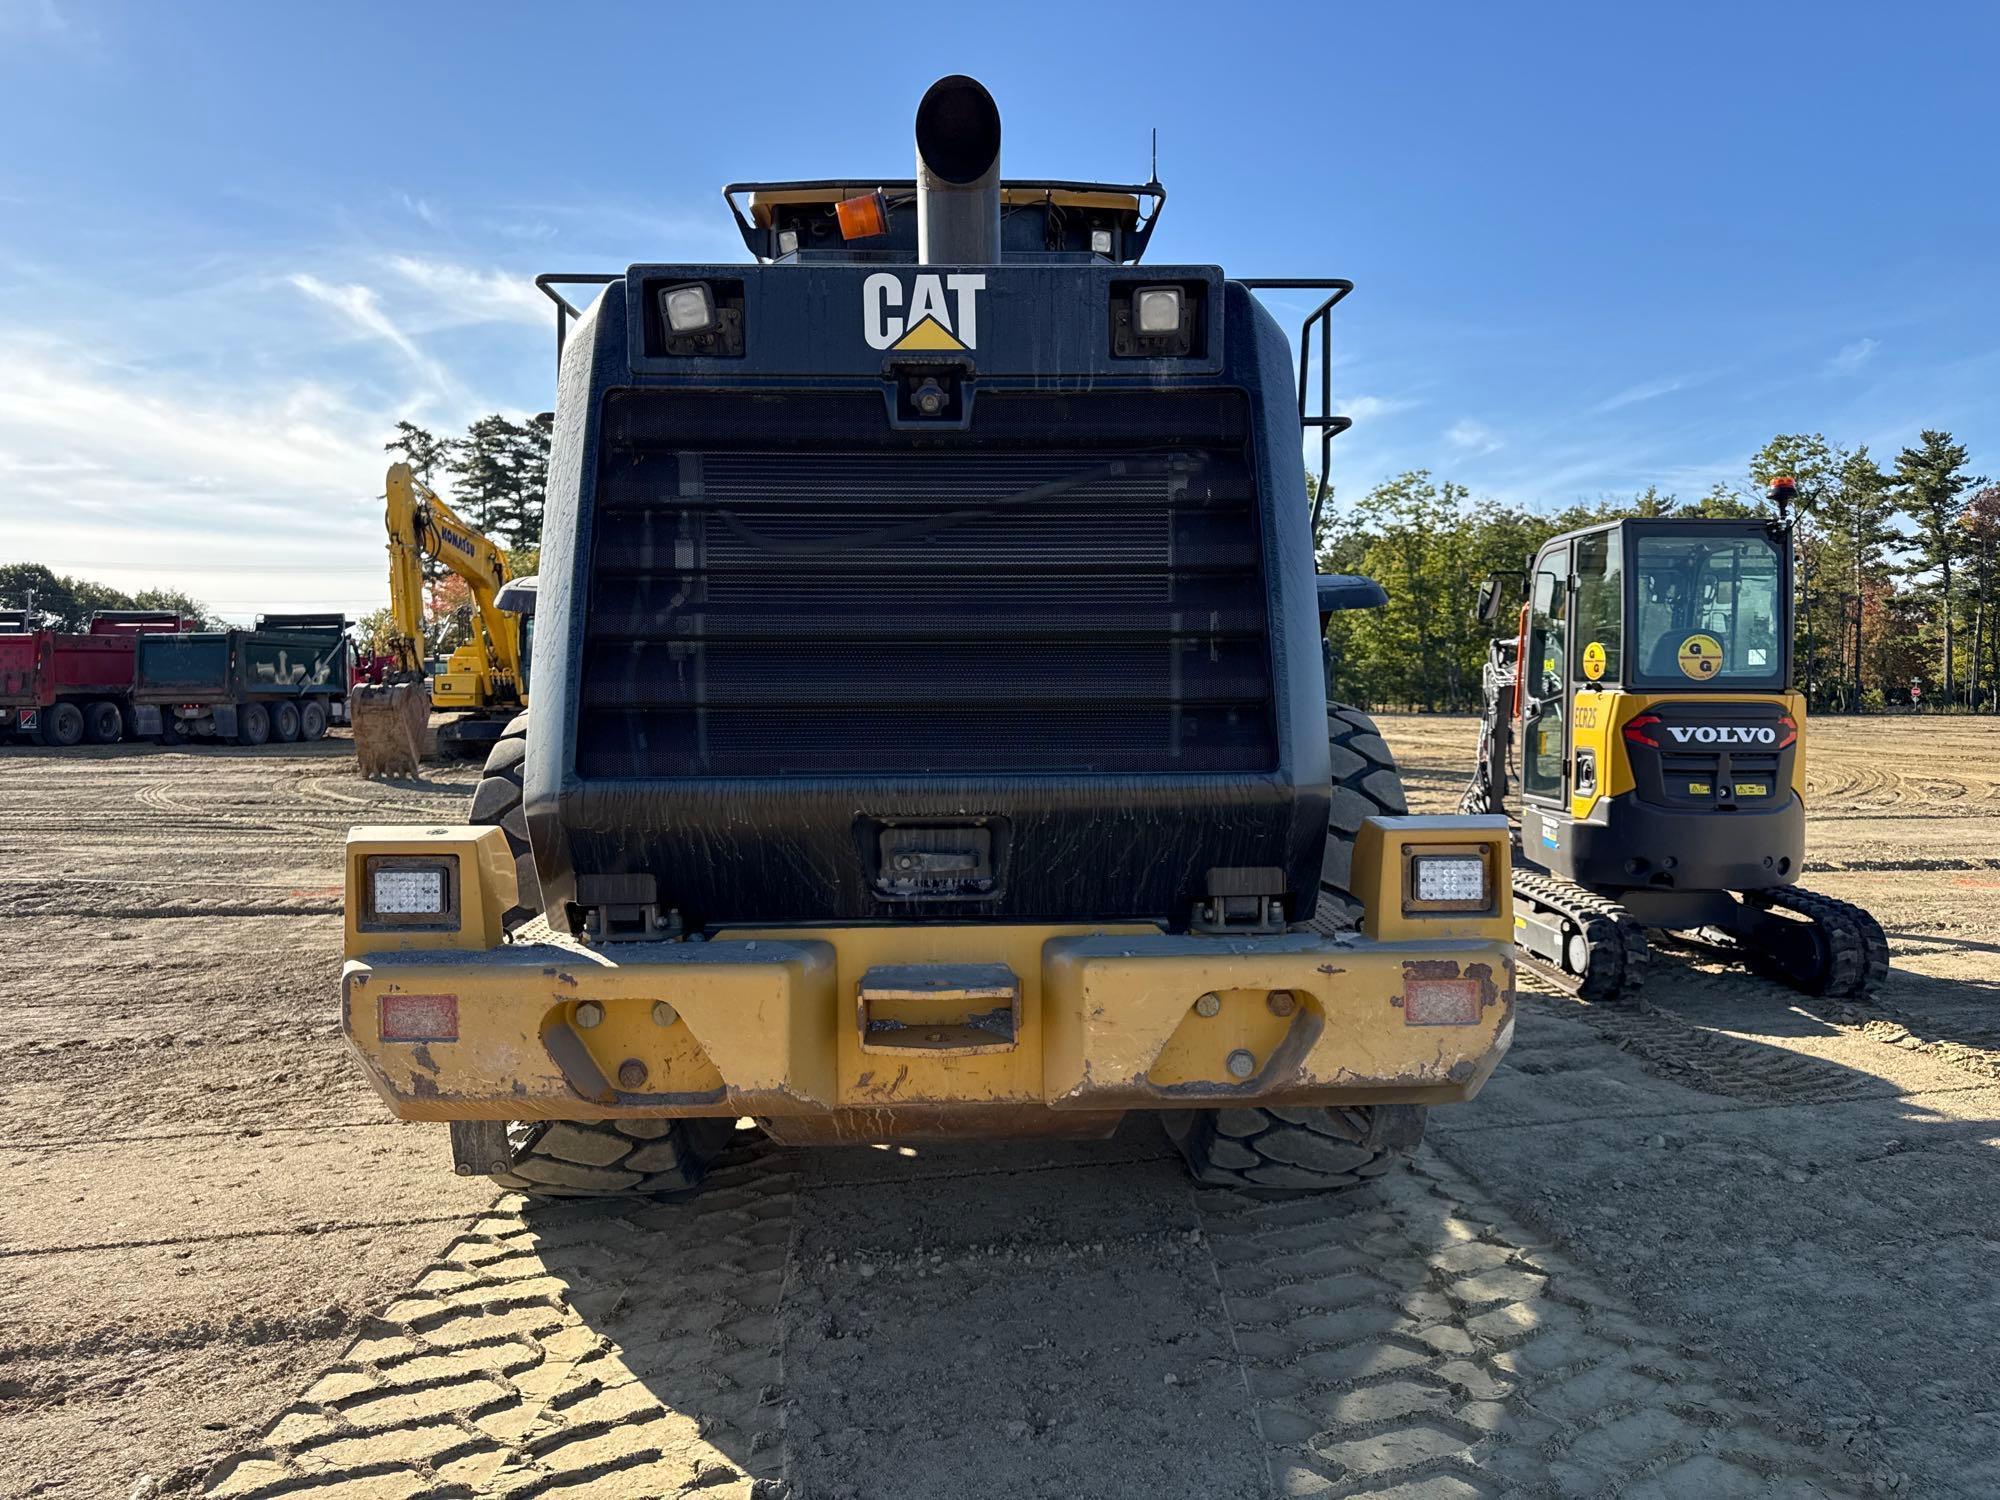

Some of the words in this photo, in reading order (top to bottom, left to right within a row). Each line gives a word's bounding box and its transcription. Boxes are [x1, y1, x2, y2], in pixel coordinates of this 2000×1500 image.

[863, 272, 986, 350] CAT
[441, 526, 475, 557] KOMATSU
[1590, 650, 1596, 659] G
[1594, 664, 1600, 673] G
[1575, 707, 1597, 728] ECR25
[1666, 727, 1776, 744] VOLVO
